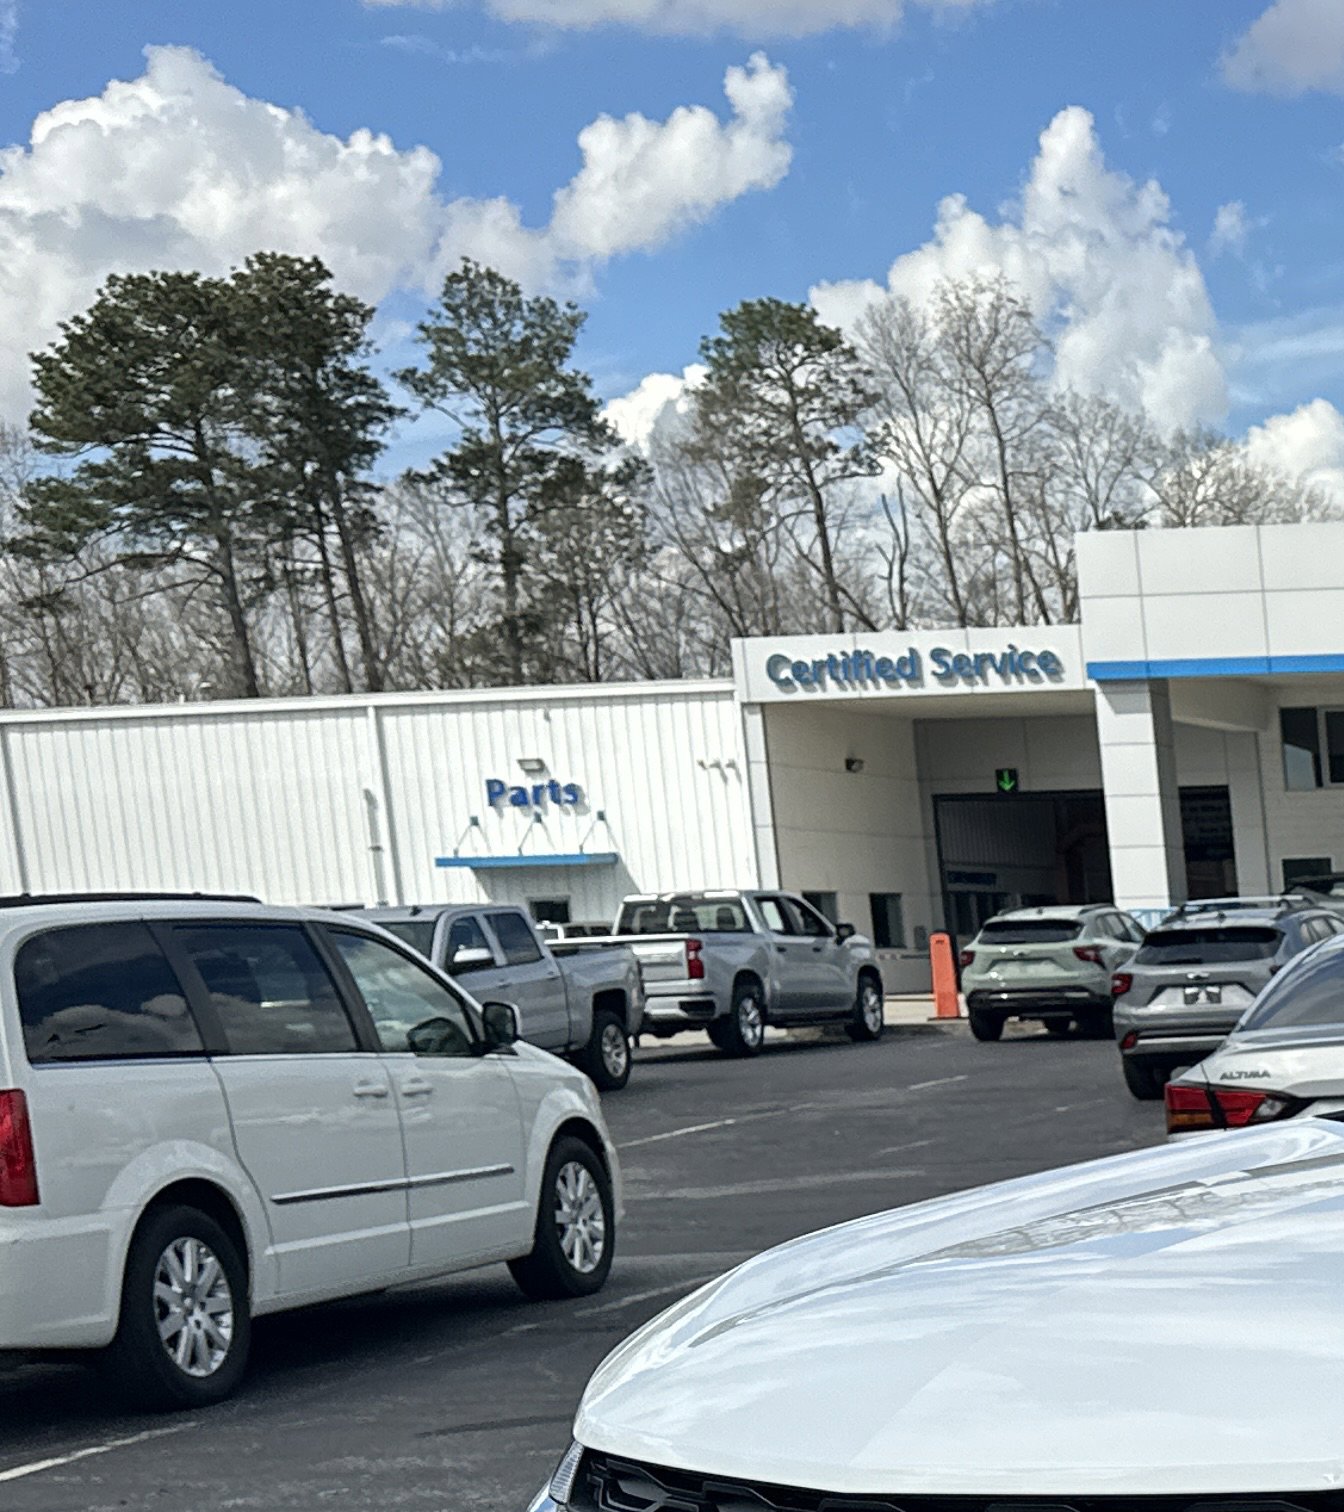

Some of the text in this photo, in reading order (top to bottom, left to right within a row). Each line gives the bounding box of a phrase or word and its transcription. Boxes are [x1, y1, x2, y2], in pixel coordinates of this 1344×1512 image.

[766, 644, 1061, 687] Certified Service
[485, 778, 581, 807] Parts
[1220, 1069, 1271, 1080] ALTIMA
